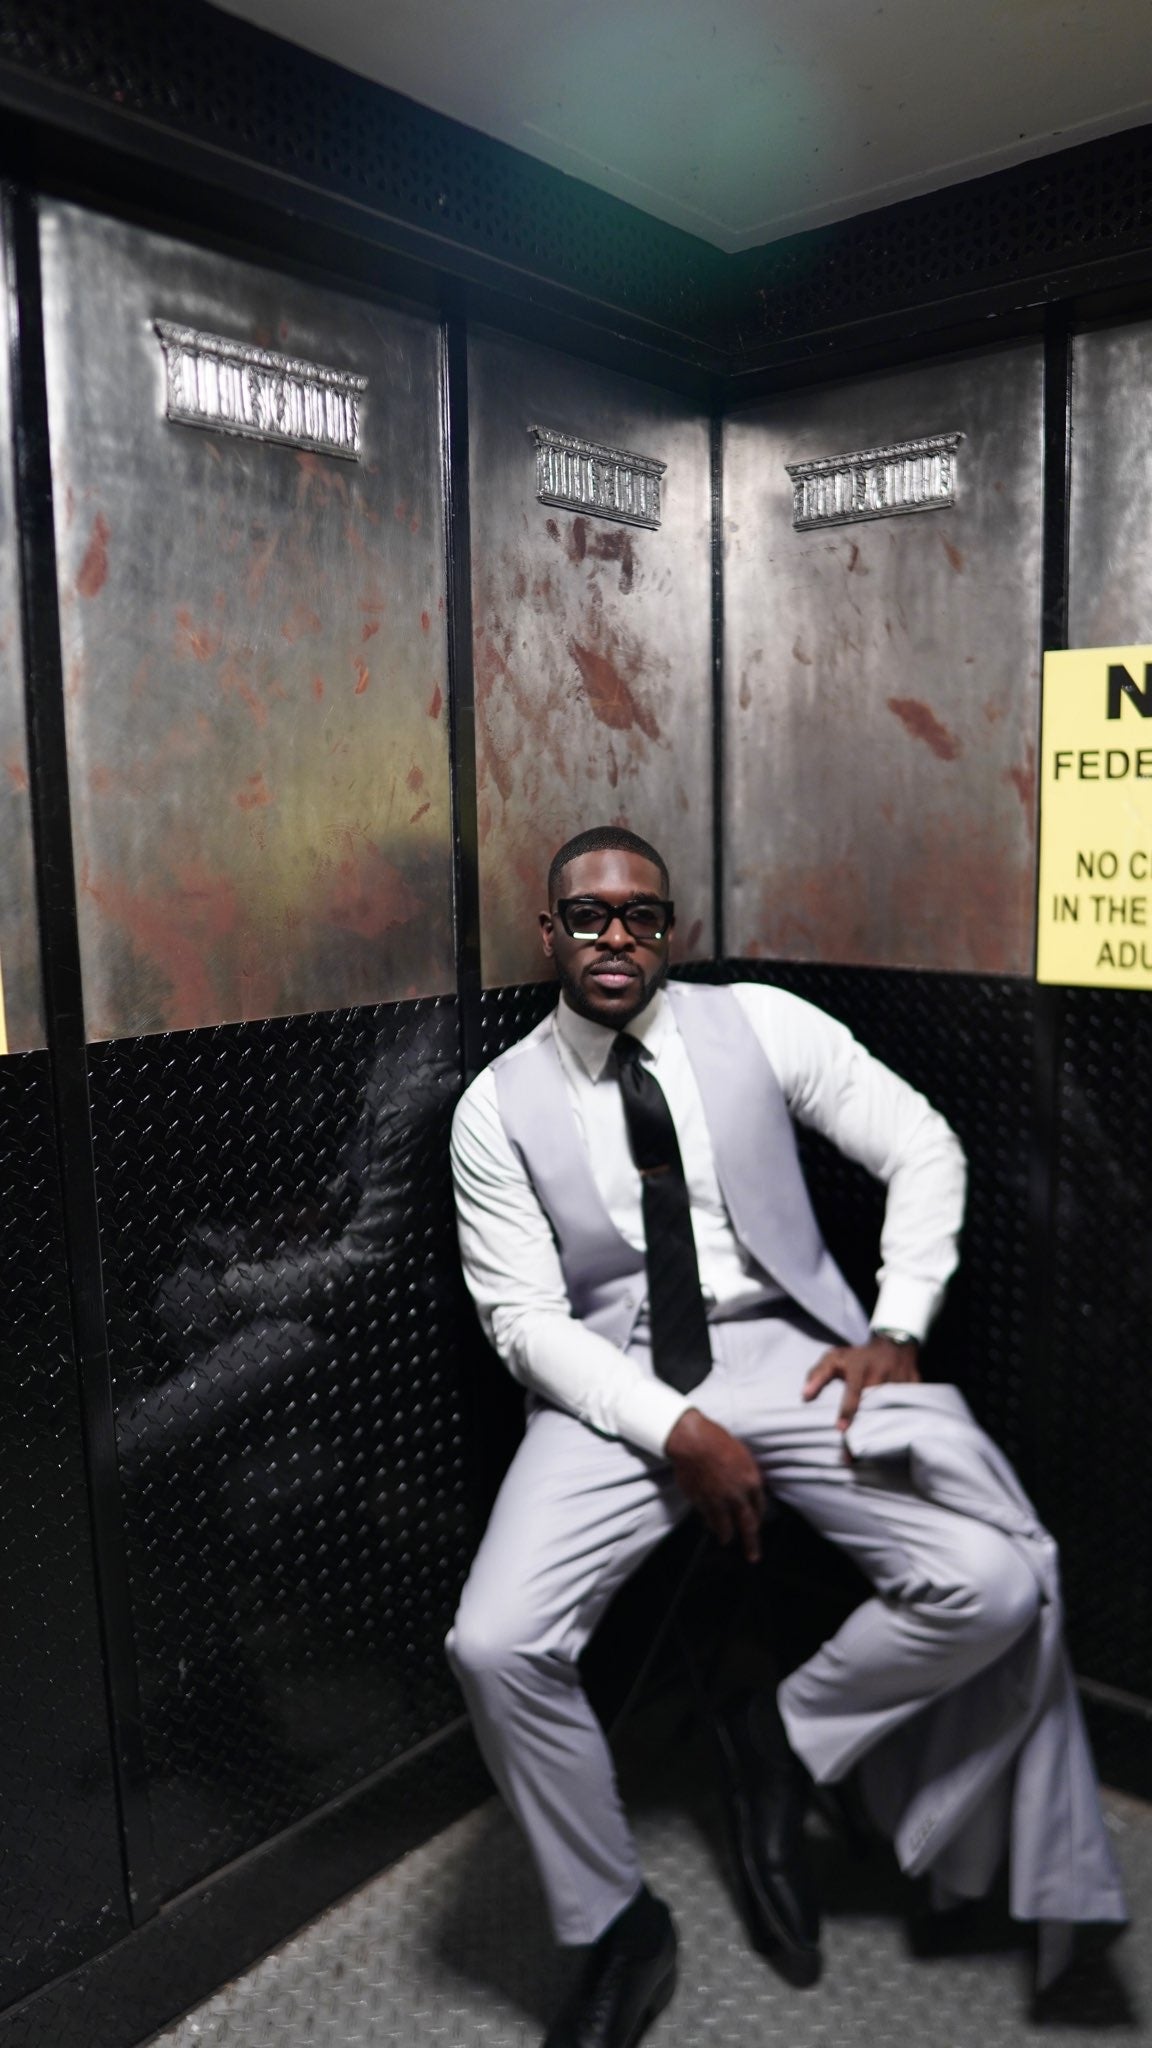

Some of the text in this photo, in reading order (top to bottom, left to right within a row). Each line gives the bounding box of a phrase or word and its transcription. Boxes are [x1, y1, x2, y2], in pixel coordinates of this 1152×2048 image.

[1054, 748, 1152, 780] FEDE
[1077, 851, 1152, 880] NO C
[1053, 896, 1147, 926] IN THE
[1096, 940, 1152, 971] ADU
